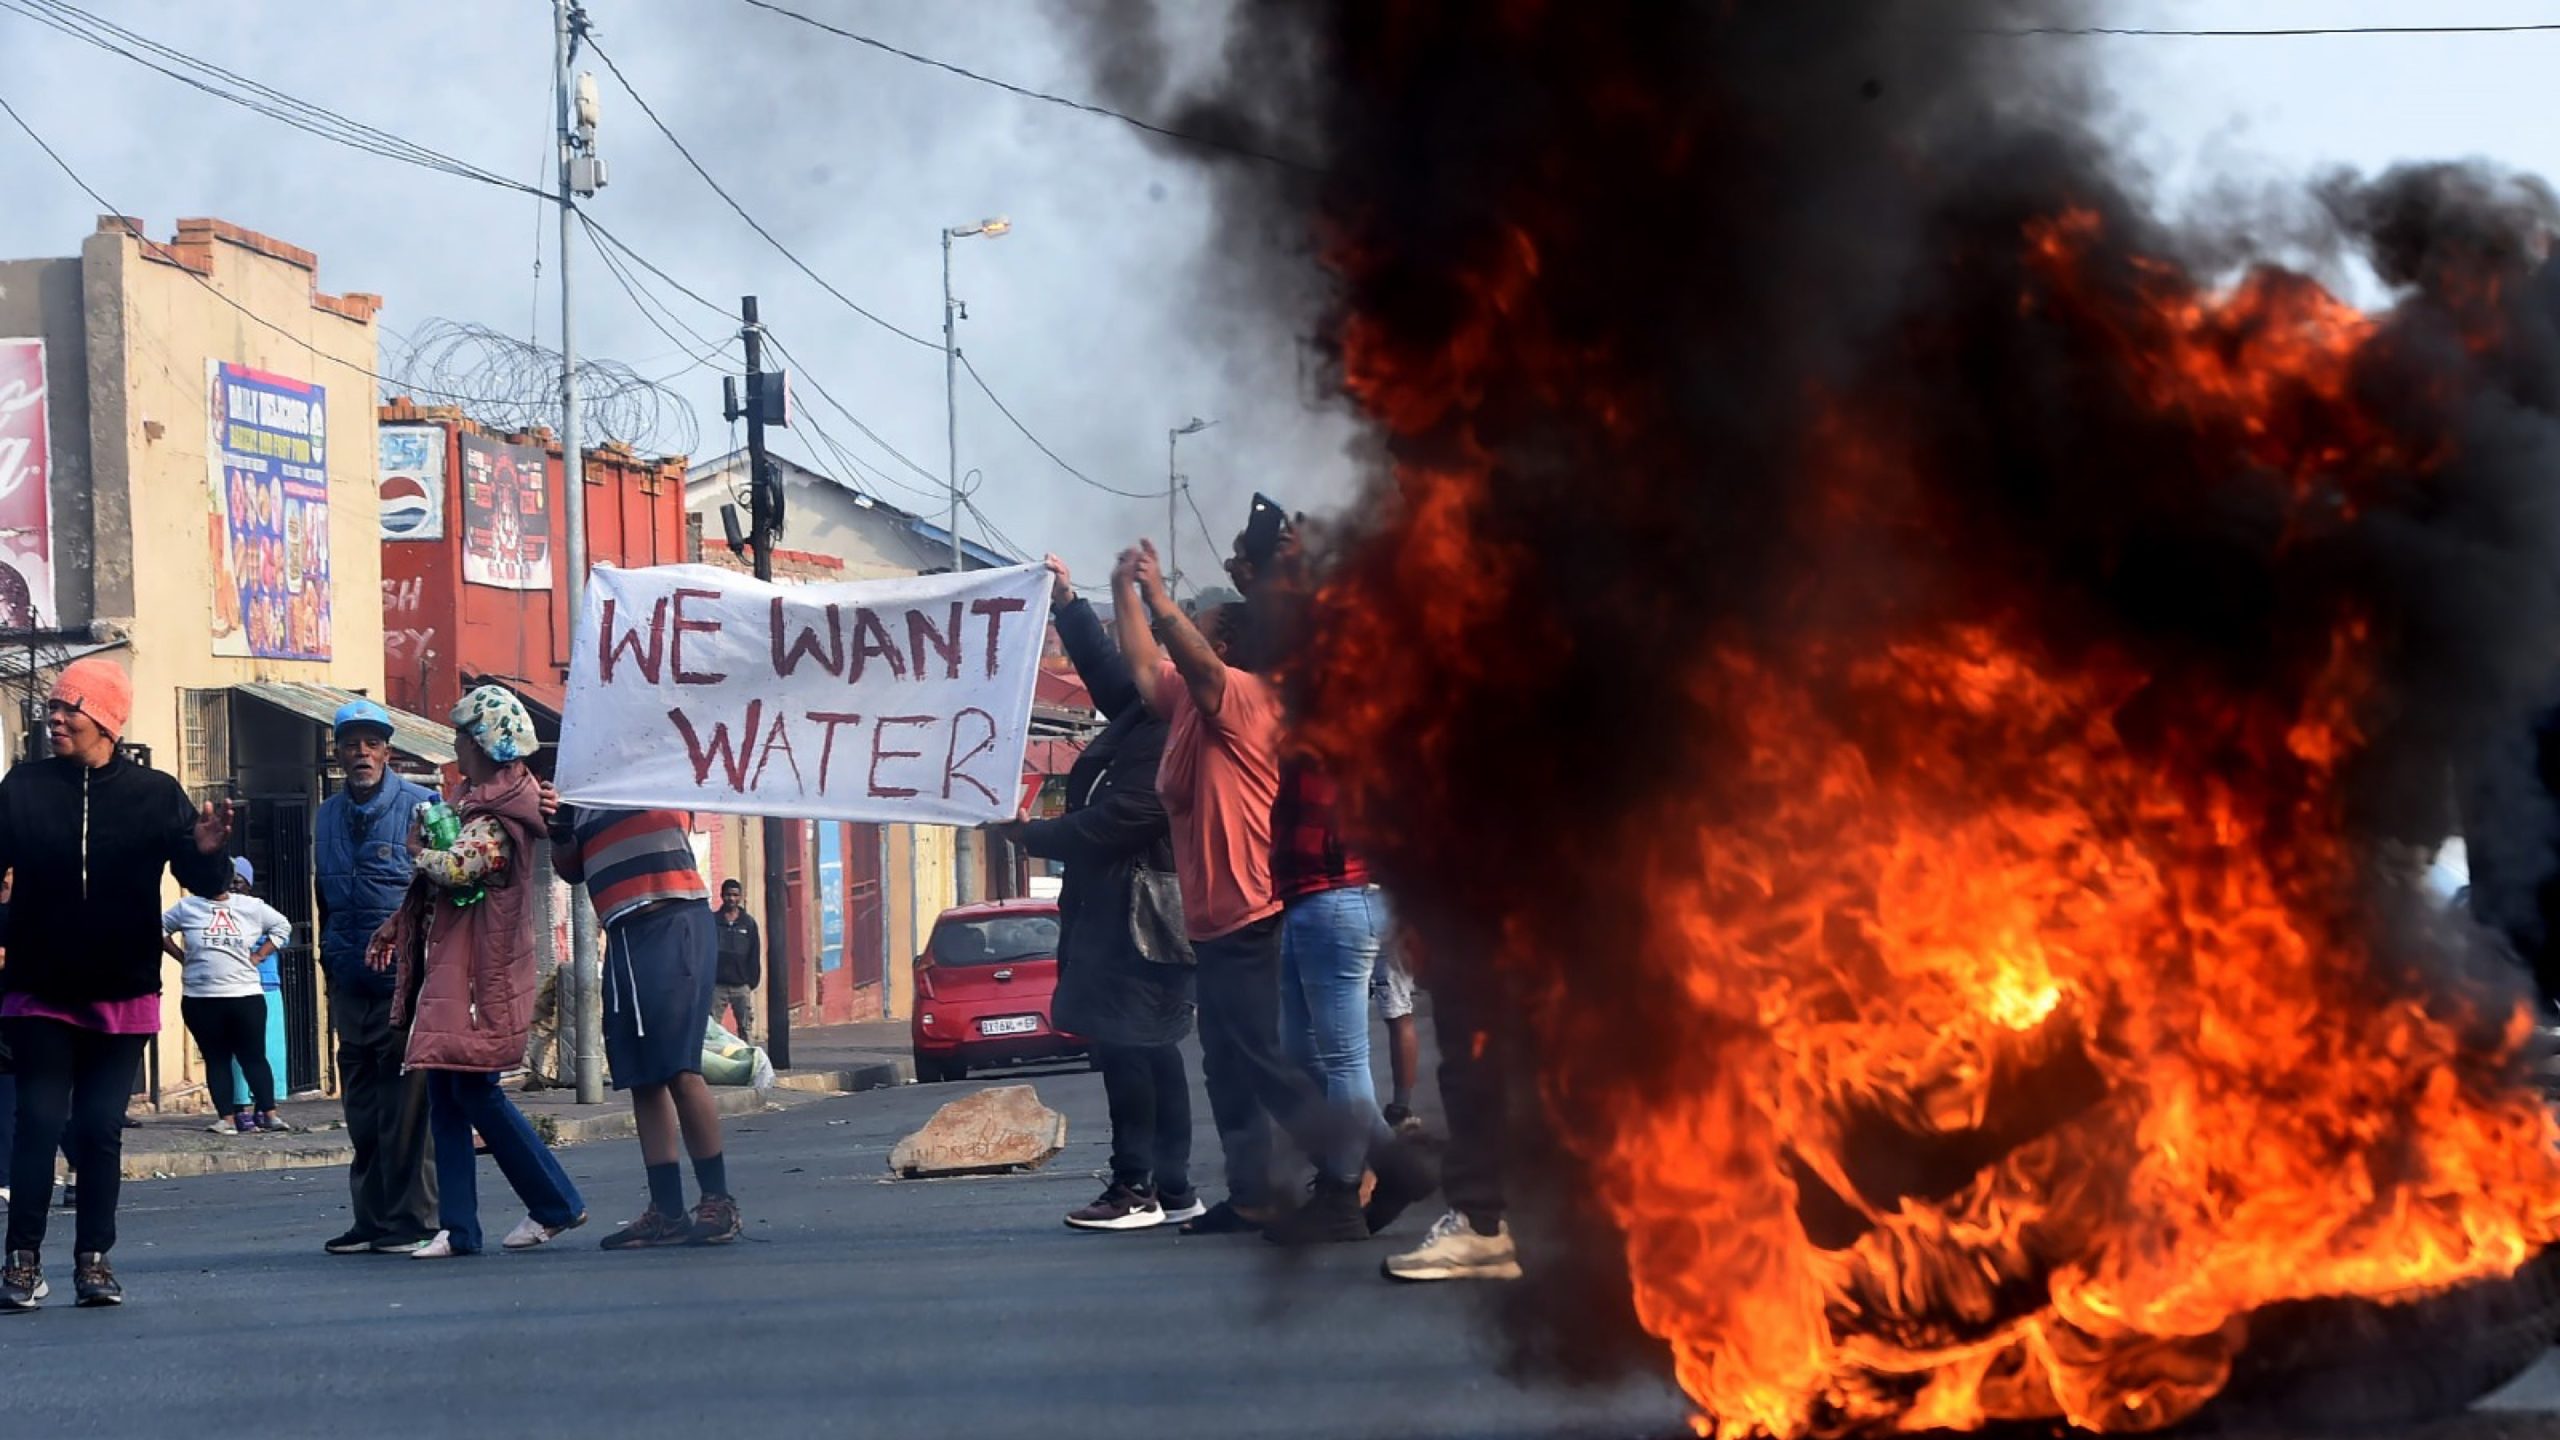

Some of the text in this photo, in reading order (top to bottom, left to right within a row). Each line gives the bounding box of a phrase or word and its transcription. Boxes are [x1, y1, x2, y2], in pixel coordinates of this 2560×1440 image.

[599, 588, 1026, 686] WE WANT
[667, 698, 1000, 806] WATER
[202, 937, 244, 947] TEAM
[203, 906, 241, 936] A
